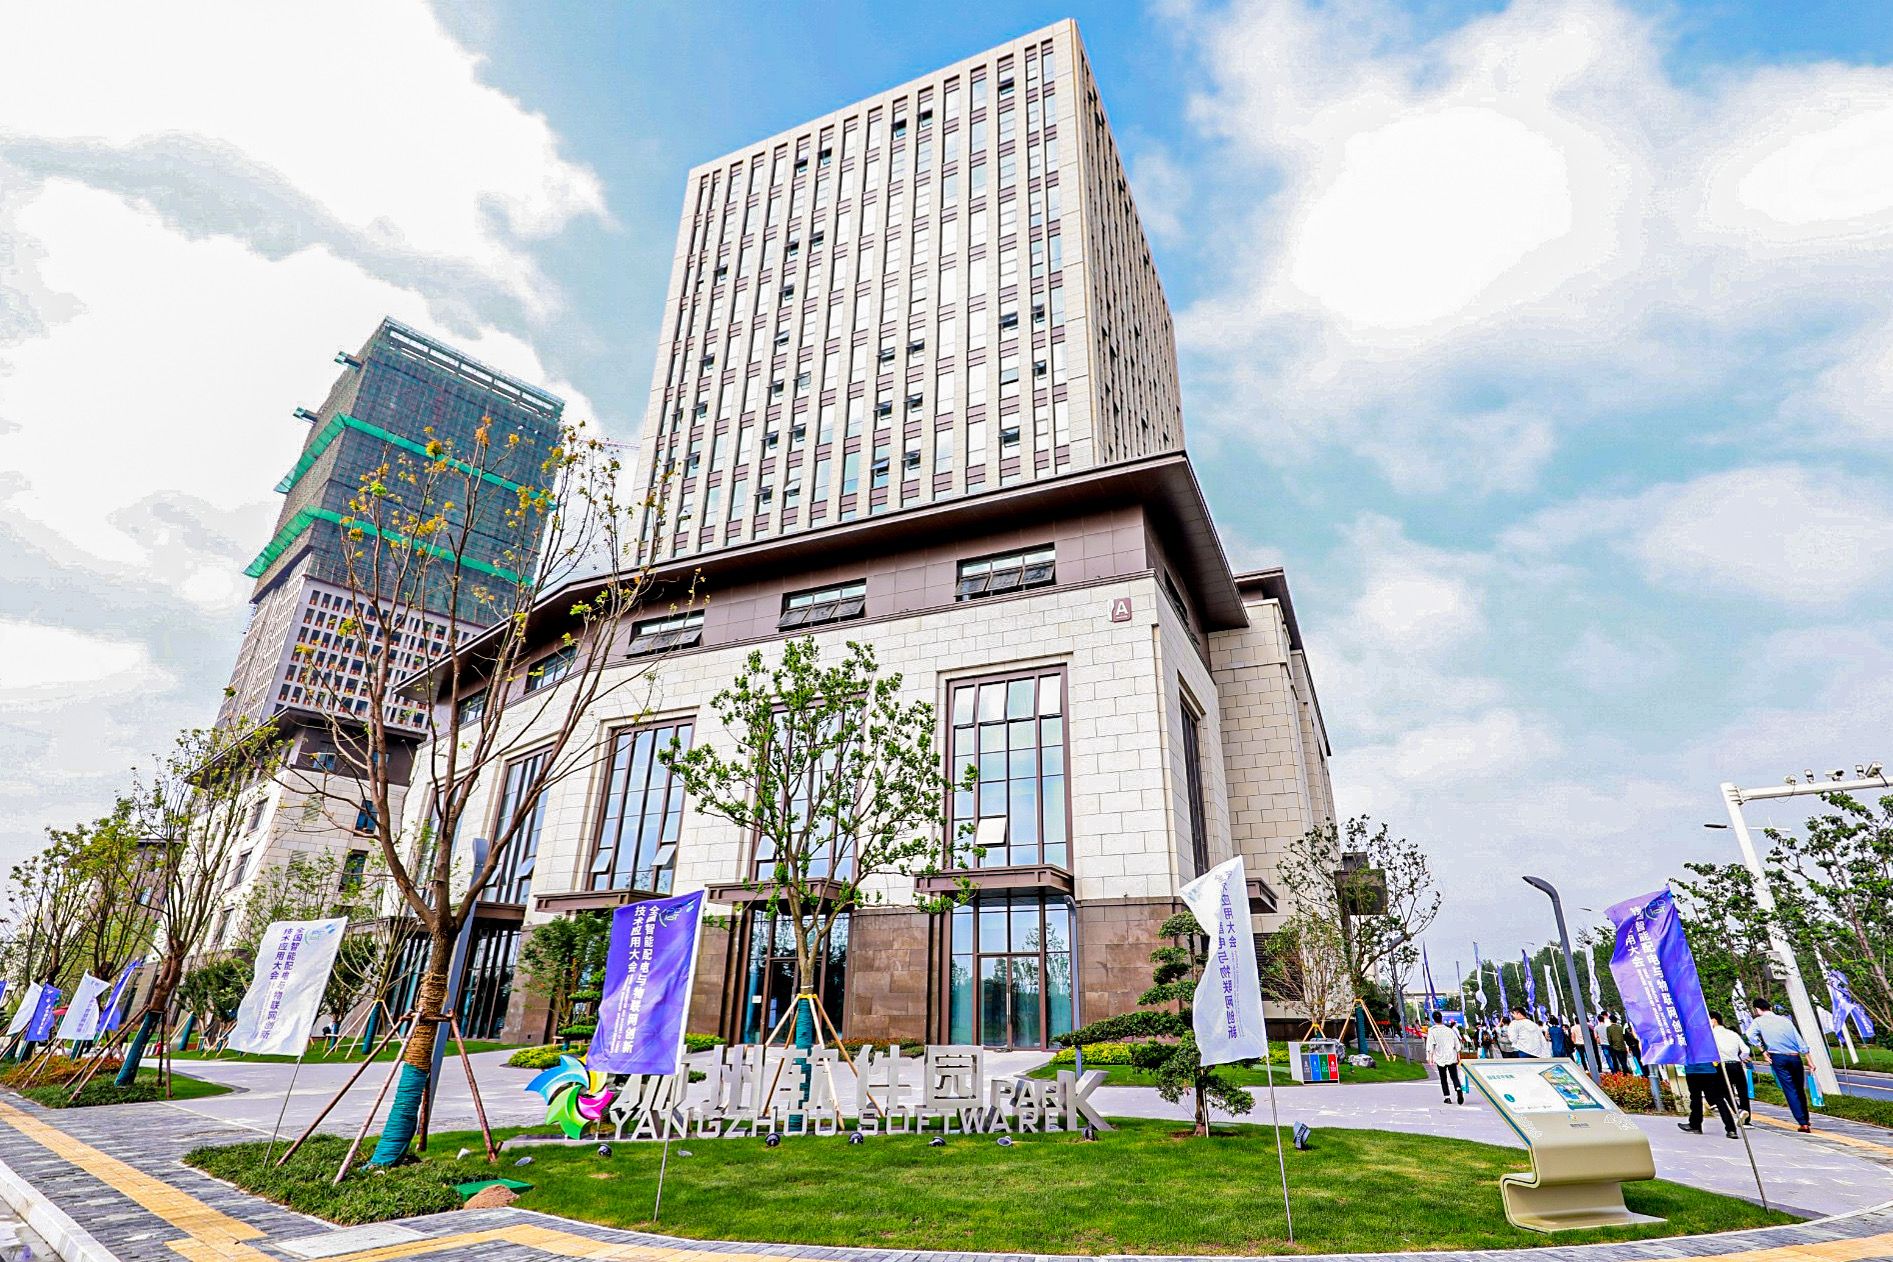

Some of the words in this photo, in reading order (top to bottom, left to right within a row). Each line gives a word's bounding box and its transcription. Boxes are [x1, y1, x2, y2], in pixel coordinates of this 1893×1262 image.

[1115, 600, 1129, 616] A
[269, 927, 293, 981] 技术应用大会
[627, 905, 646, 974] 技术应用大会
[610, 1108, 838, 1141] YANGZHOU
[856, 1106, 1065, 1136] SOFTWARE
